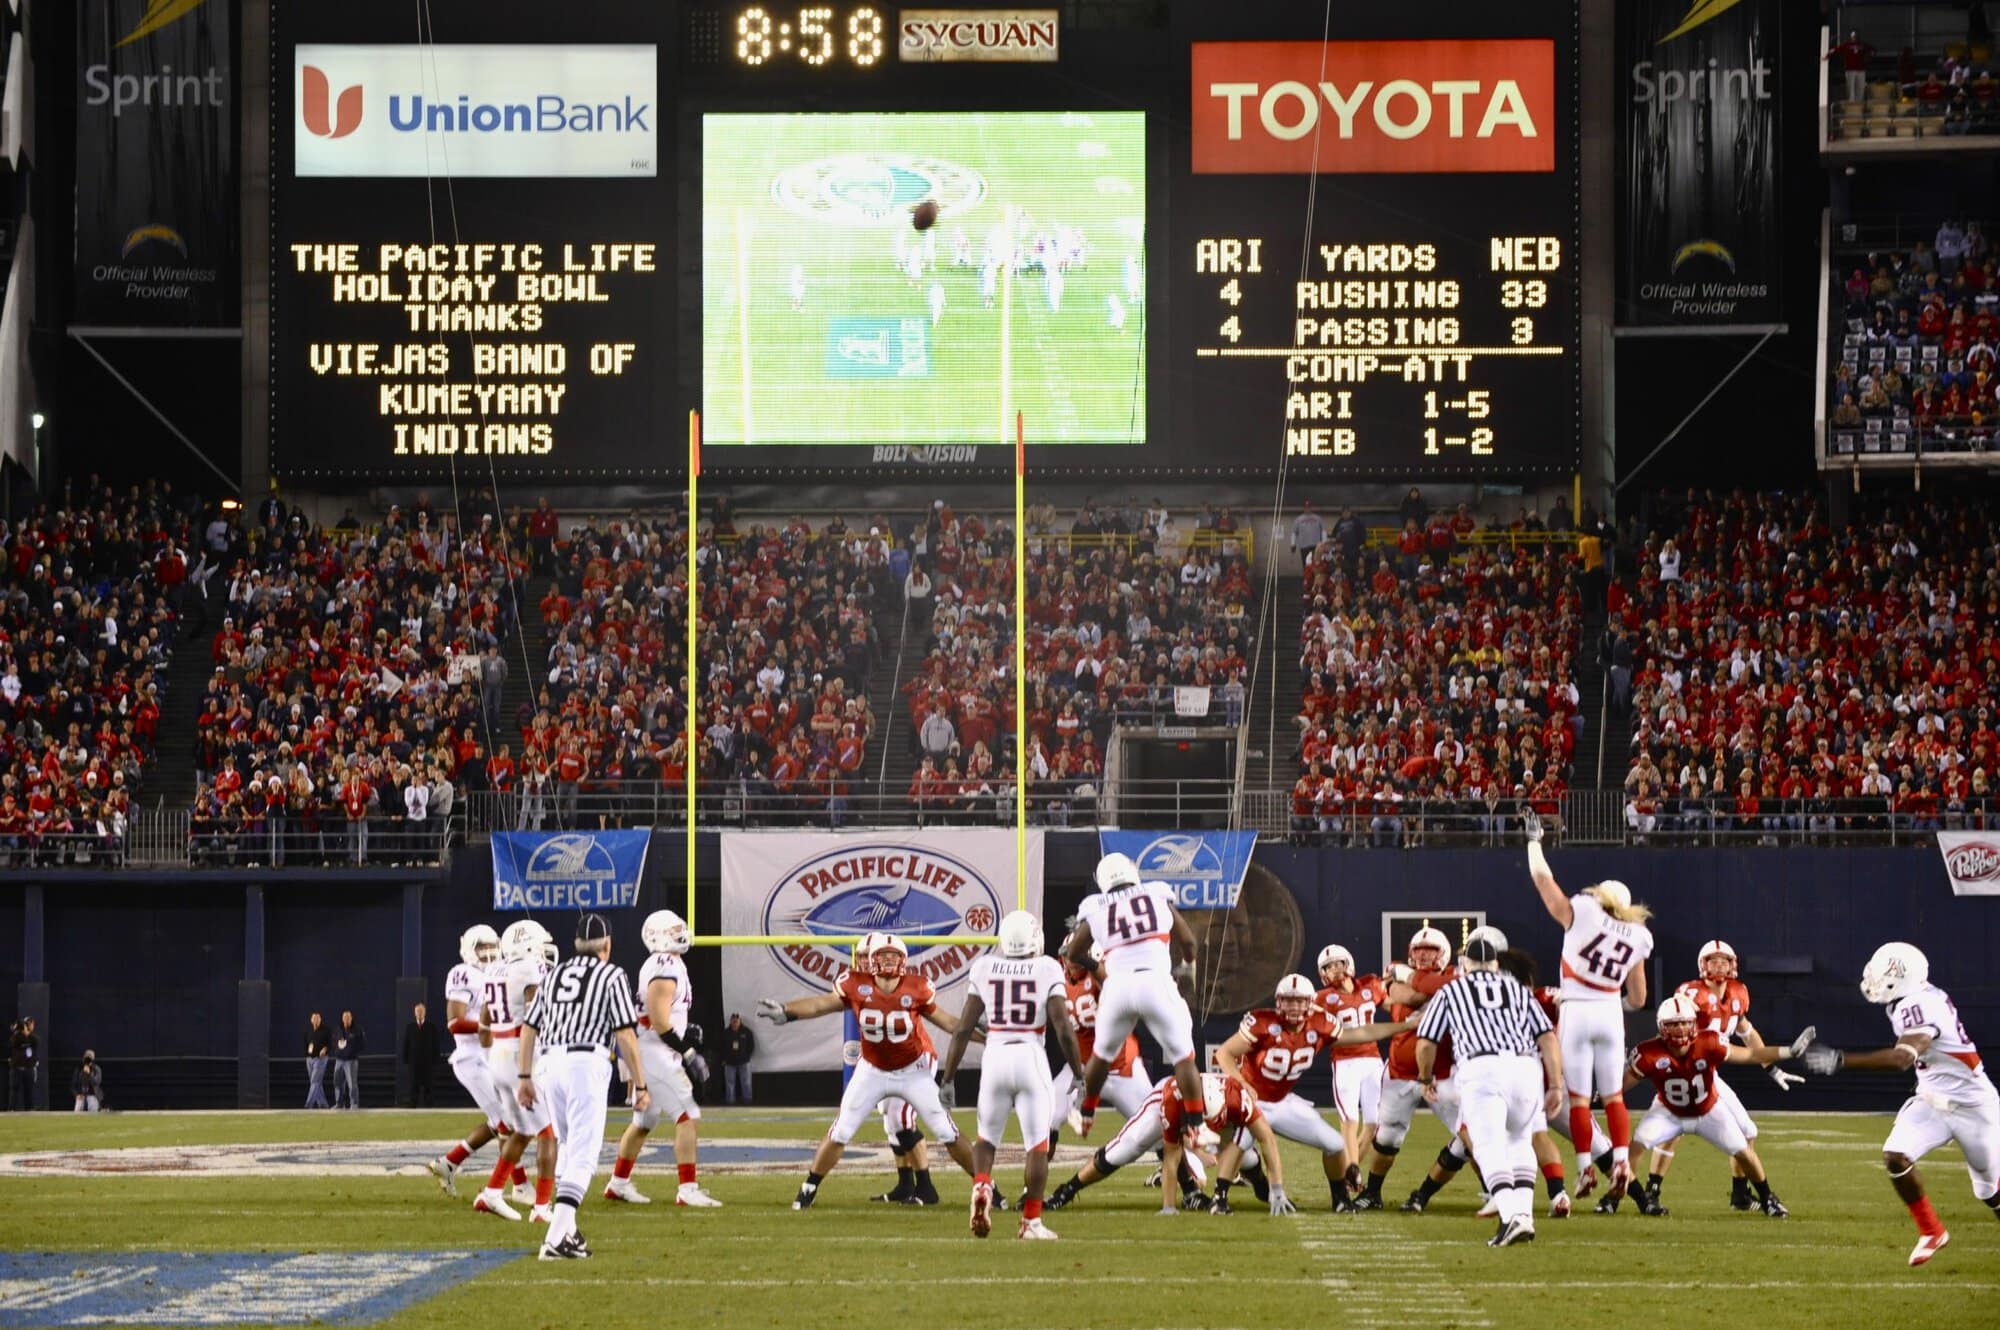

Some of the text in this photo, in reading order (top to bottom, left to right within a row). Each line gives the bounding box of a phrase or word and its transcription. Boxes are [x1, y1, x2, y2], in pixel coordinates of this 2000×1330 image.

[738, 8, 882, 65] 8:58
[903, 21, 1056, 48] SYCUAN
[85, 64, 224, 117] Sprint
[1632, 58, 1772, 113] Sprint
[389, 95, 650, 133] UnionBank
[1210, 79, 1538, 140] TOYOTA
[291, 244, 655, 272] THE PACIFIC LIFE
[1196, 237, 1560, 273] ARI YARDS NEB
[92, 264, 217, 282] Official Wireless
[333, 274, 609, 302] HOLIDAY BOWL
[125, 282, 191, 299] Provider
[1220, 280, 1547, 309] 4 RUSHING 33
[1640, 282, 1768, 299] Official Wireless
[404, 304, 543, 332] THANKS
[1671, 299, 1738, 315] Provider
[1220, 316, 1534, 345] 4 PASSING 3
[310, 344, 636, 374] VIEJAS BAND OF
[1287, 355, 1473, 382] COMP-ATT
[379, 384, 566, 415] KUMEYAAY
[1286, 391, 1490, 419] ARI 1-5
[393, 424, 553, 454] INDIANS
[872, 445, 978, 463] BOLT VISION
[1286, 428, 1494, 456] NEB 1-2
[496, 879, 634, 908] PACIFIC LIF
[1202, 880, 1240, 906] LIF
[1107, 894, 1159, 940] 49
[1578, 931, 1635, 982] 42
[556, 966, 586, 1002] S
[1473, 980, 1504, 1010] U
[484, 981, 514, 1024] 21
[987, 979, 1038, 1025] 15
[1900, 1003, 1925, 1029] 20
[859, 1007, 914, 1044] 80
[1260, 1046, 1315, 1082] 92
[1664, 1073, 1709, 1107] 81
